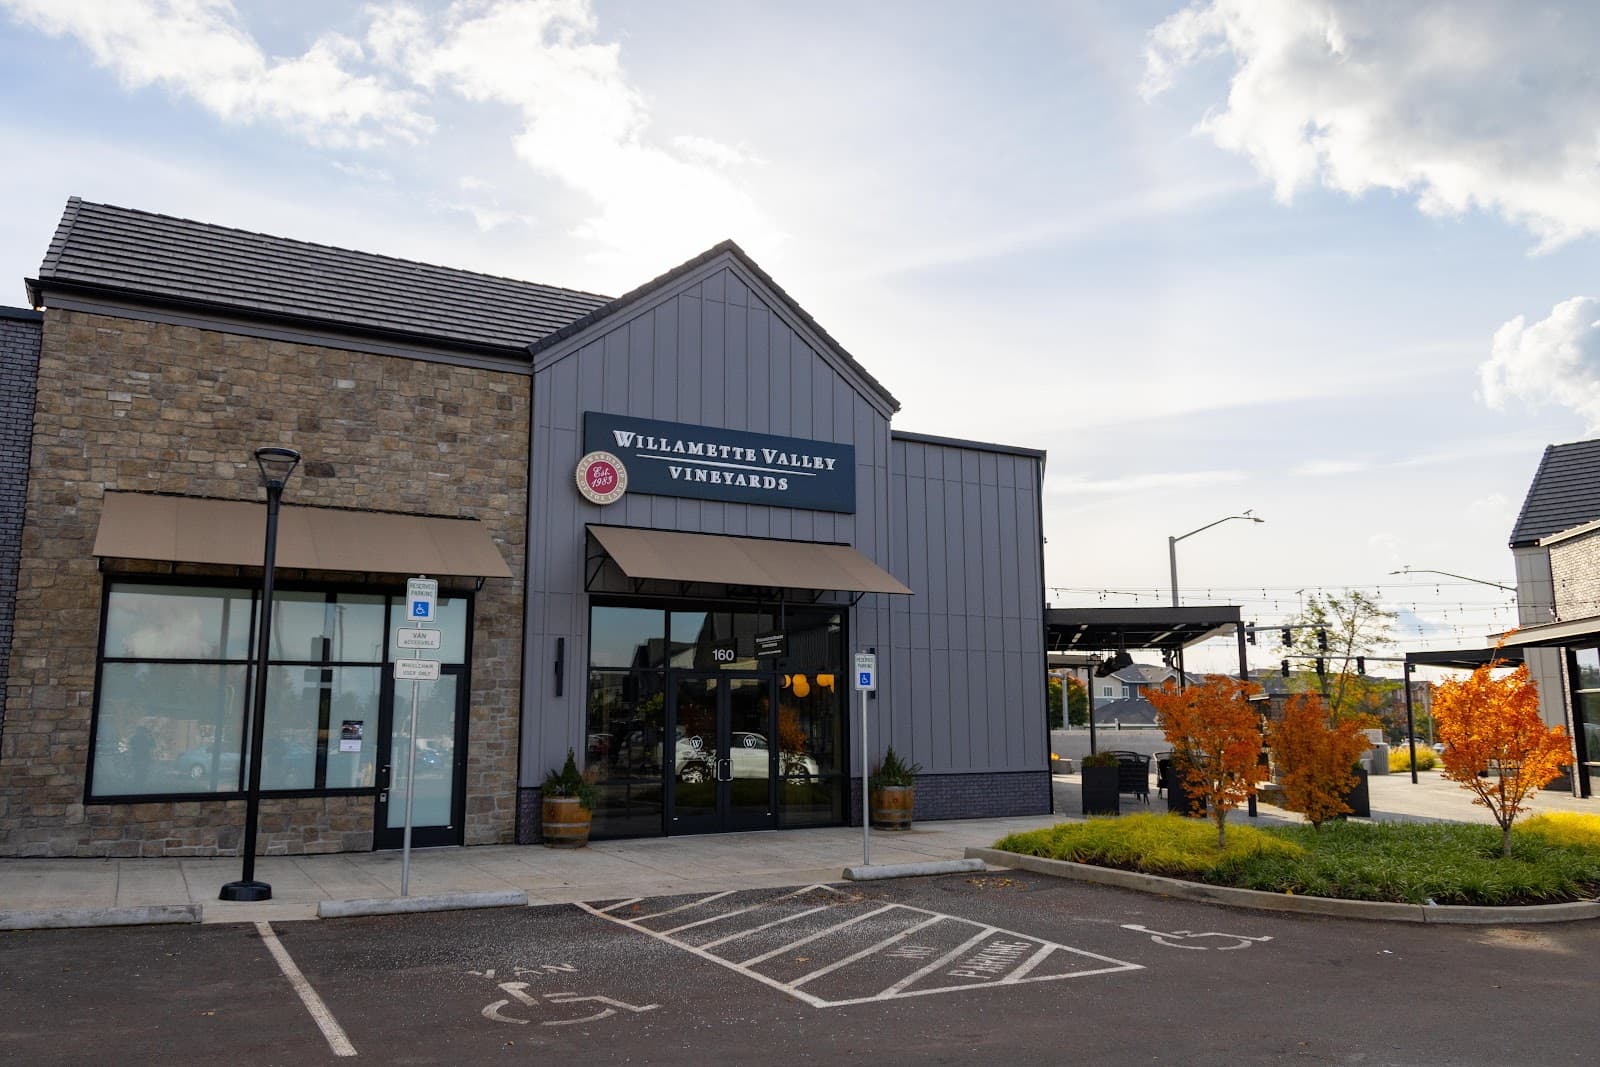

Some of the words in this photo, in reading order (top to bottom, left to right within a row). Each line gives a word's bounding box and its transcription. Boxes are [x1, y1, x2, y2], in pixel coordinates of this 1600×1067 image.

[612, 429, 756, 462] WILLAMETTE
[761, 447, 836, 471] VALLEY
[668, 465, 789, 491] VINEYARDS
[712, 648, 735, 661] 160
